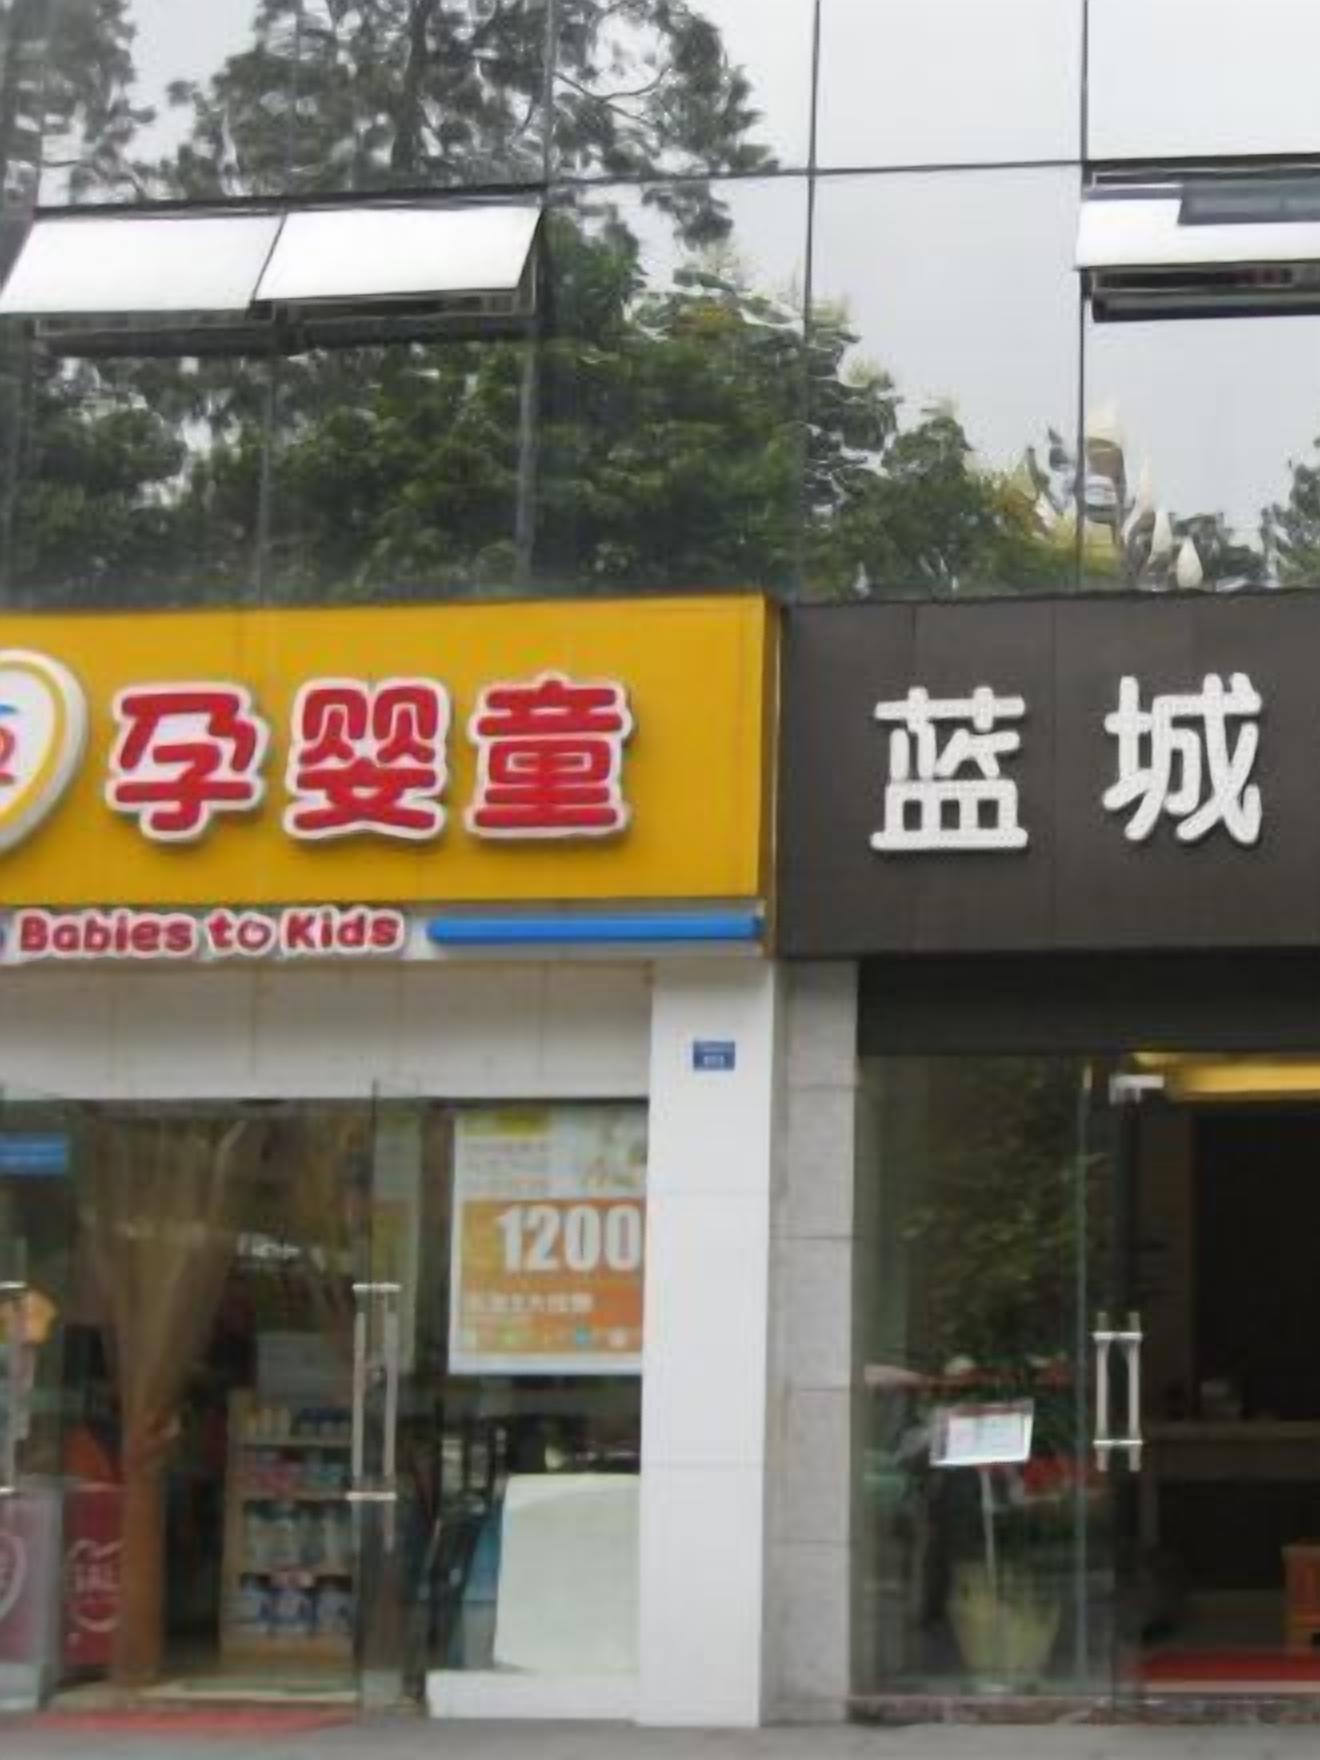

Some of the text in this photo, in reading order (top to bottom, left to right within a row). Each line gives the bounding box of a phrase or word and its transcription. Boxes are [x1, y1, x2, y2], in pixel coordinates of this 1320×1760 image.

[107, 676, 630, 838] 孕婴童
[18, 909, 402, 954] Babies to Kids
[497, 1204, 643, 1272] 1200
